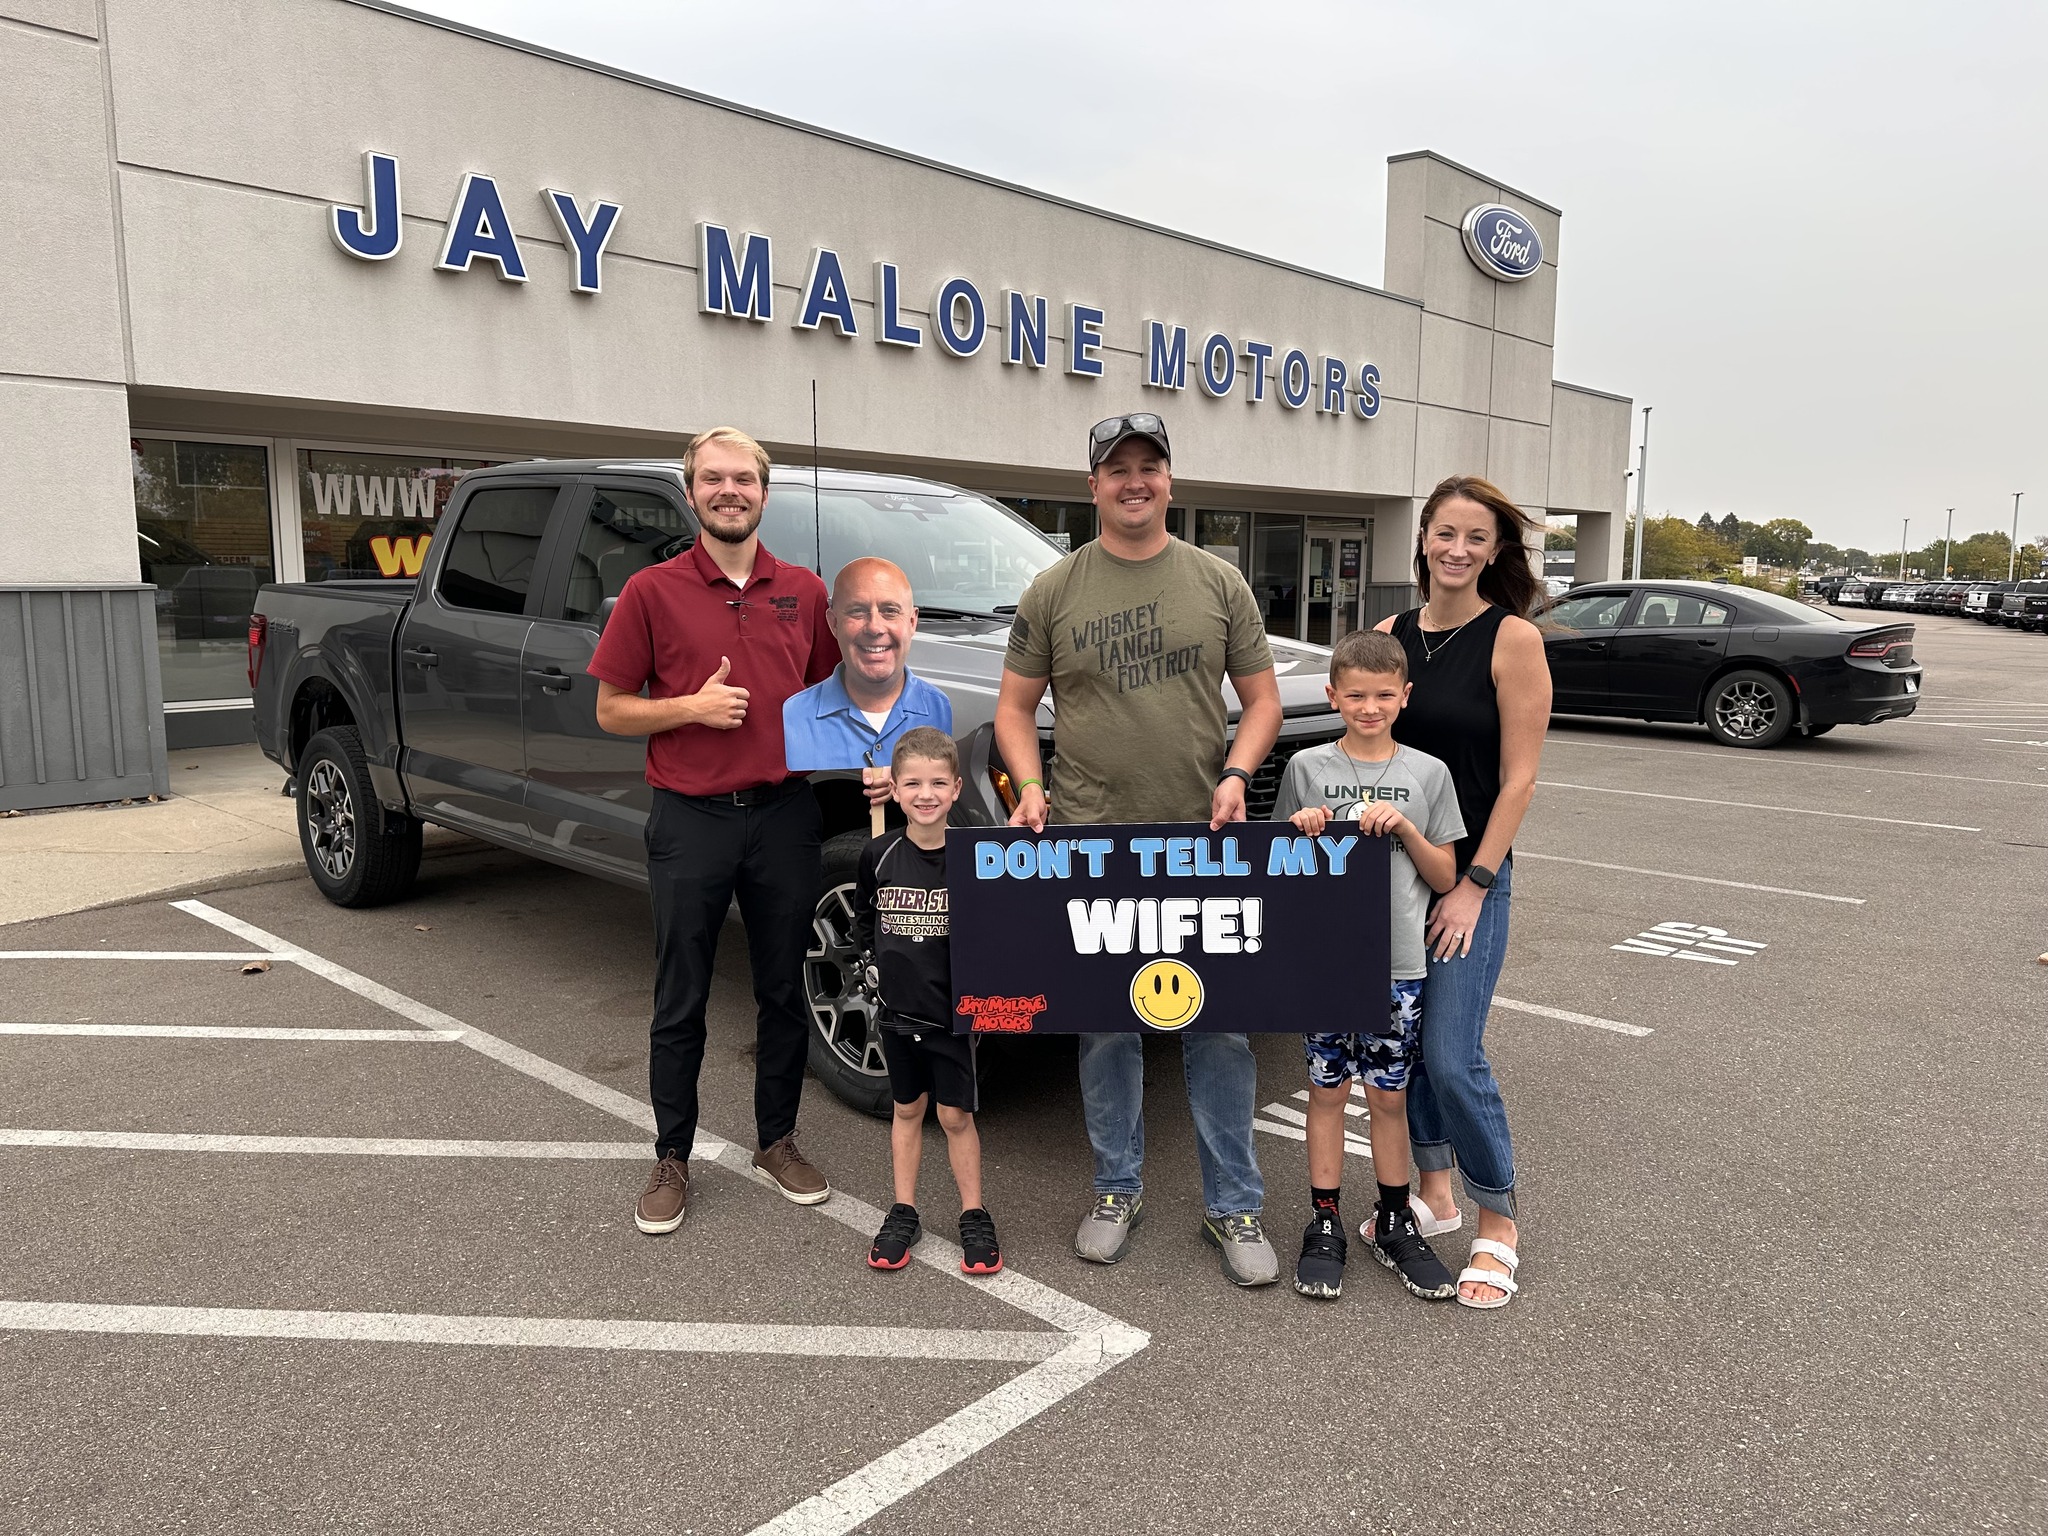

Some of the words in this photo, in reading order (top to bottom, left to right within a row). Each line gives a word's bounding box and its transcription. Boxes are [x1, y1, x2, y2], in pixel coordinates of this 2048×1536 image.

[1490, 219, 1532, 265] Ford
[327, 150, 624, 295] JAY
[696, 221, 1105, 378] MALONE
[1141, 318, 1382, 421] MOTORS
[1071, 601, 1158, 653] WHISKEY
[1095, 626, 1163, 672] TANGO
[1117, 643, 1203, 694] FOXTROT
[1324, 785, 1410, 802] UNDER
[975, 838, 1113, 880] DON'T
[1130, 837, 1251, 877] TELL
[1267, 836, 1358, 877] MY
[1066, 897, 1263, 954] WIFE!
